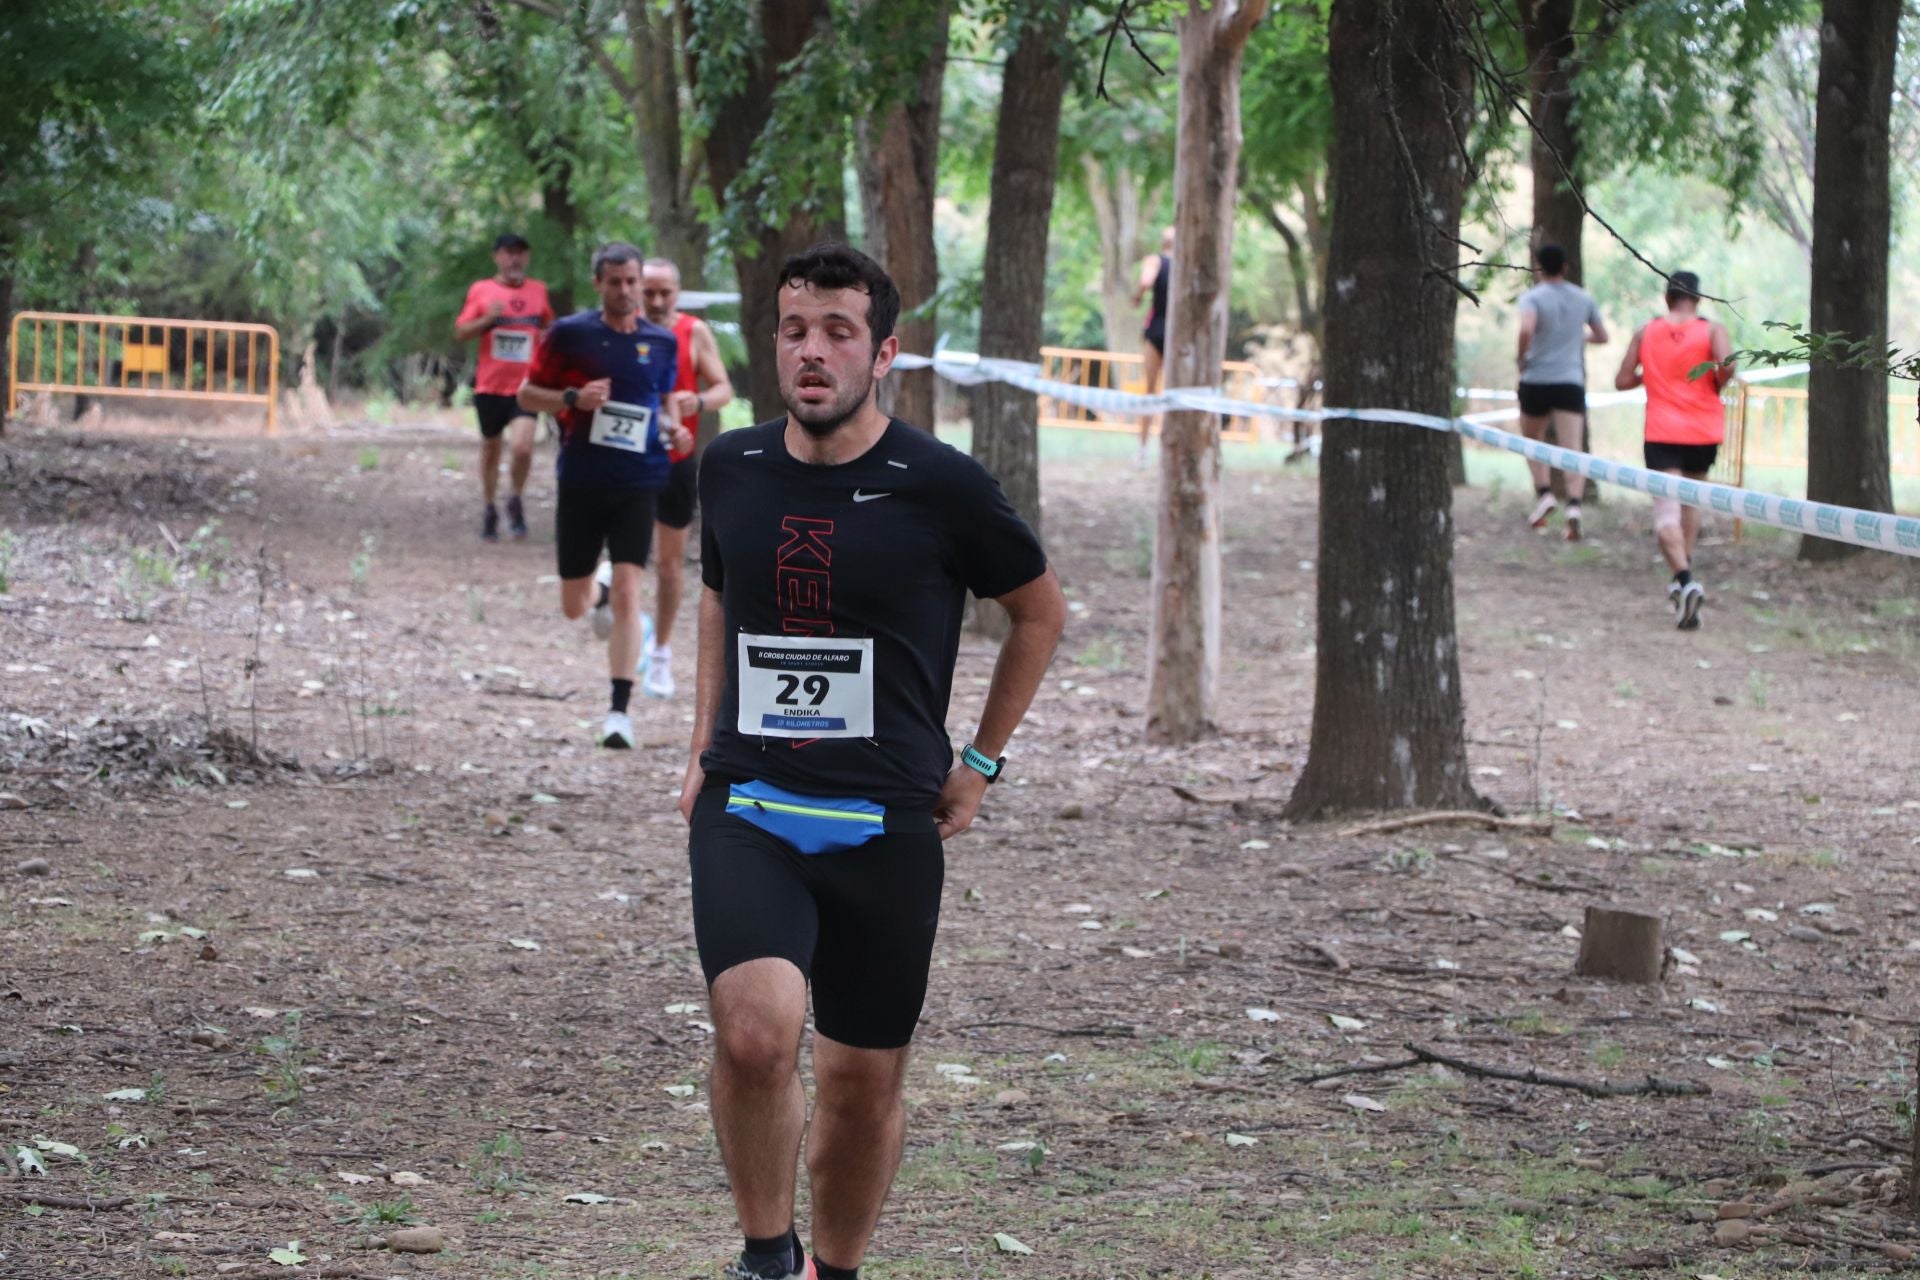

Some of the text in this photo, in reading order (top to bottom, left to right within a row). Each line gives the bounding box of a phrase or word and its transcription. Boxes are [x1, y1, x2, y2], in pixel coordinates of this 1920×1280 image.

[611, 420, 633, 434] 22
[763, 652, 785, 660] CROSS
[822, 654, 850, 662] ALFARO
[776, 674, 830, 706] 29
[786, 720, 829, 728] KILOMETROS
